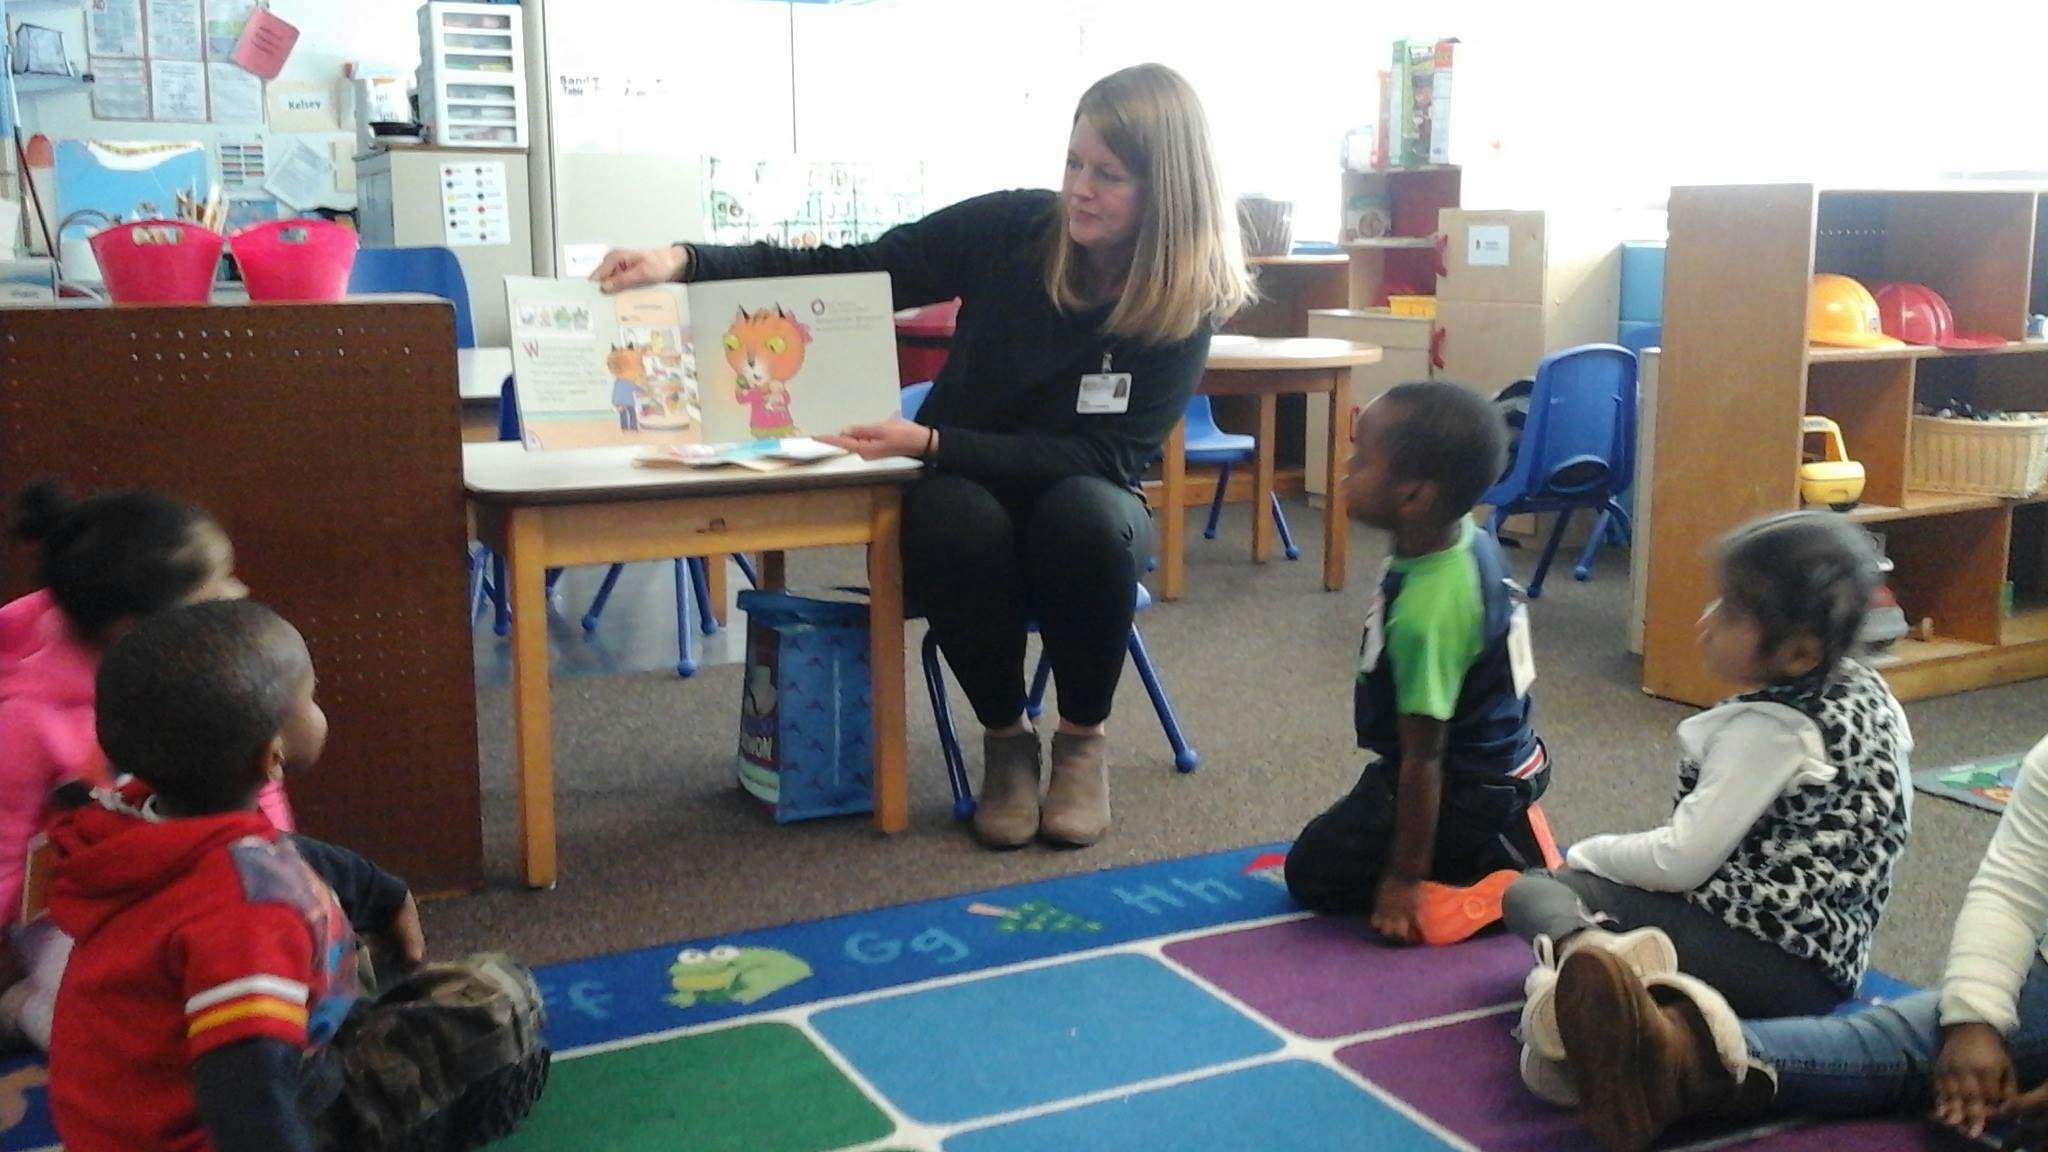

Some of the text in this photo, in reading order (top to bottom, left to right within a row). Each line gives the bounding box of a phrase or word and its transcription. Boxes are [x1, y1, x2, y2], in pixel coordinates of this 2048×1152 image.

[288, 99, 321, 112] Kelsey
[523, 339, 539, 358] W
[845, 927, 970, 964] Gg
[1111, 878, 1244, 916] Hh
